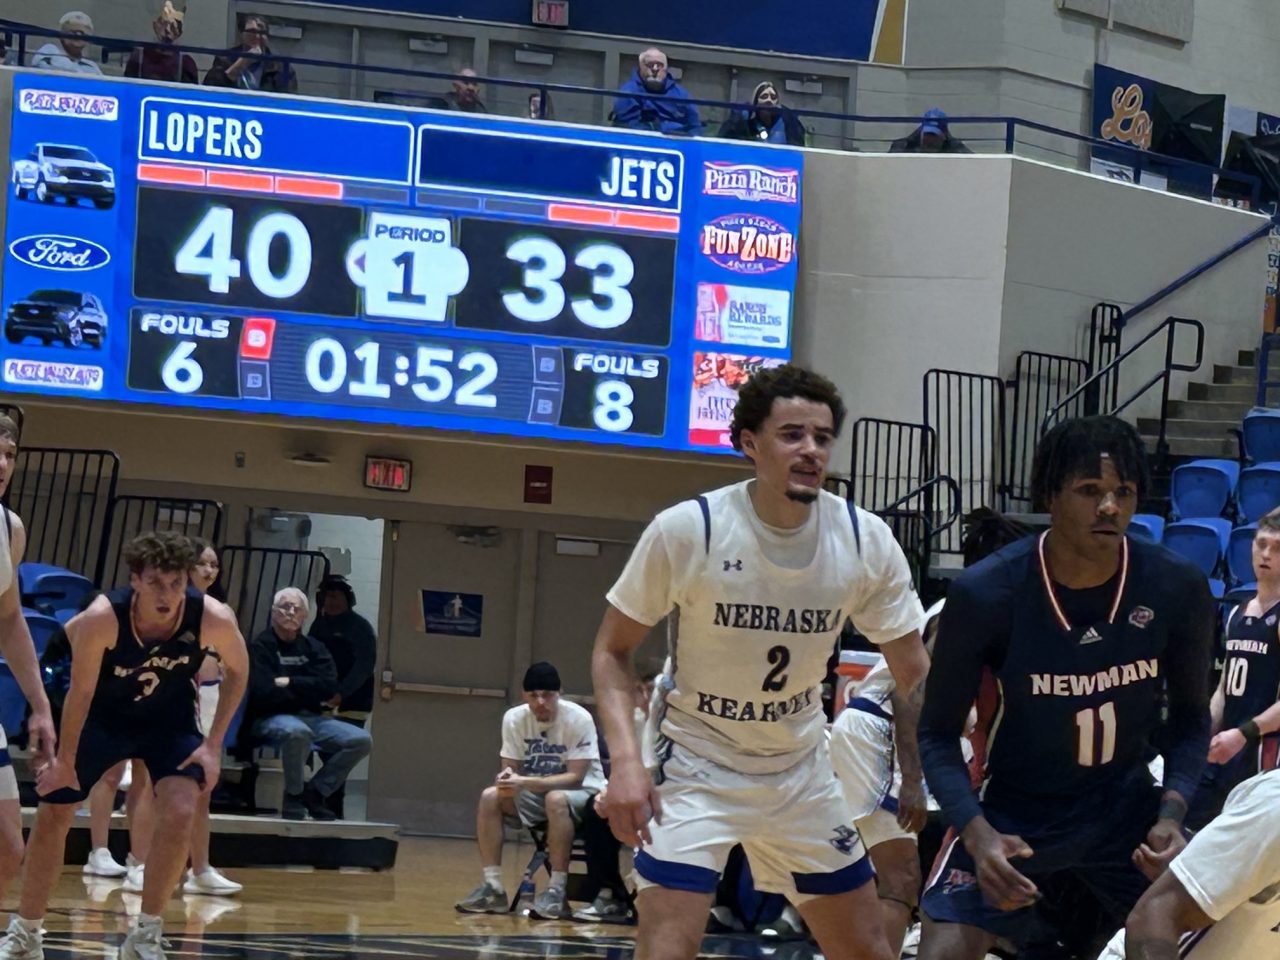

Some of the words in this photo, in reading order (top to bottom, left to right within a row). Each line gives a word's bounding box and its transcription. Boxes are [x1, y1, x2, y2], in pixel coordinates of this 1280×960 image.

[148, 110, 264, 160] LOPERS
[601, 156, 674, 202] JETS
[28, 238, 90, 268] Ford
[174, 206, 312, 299] 40
[375, 223, 446, 243] PERIOD
[386, 251, 427, 306] 1
[502, 236, 634, 330] 33
[140, 313, 230, 339] FOULS
[161, 342, 204, 394] 6
[305, 337, 498, 409] 01:52
[574, 352, 660, 379] FOULS
[592, 381, 635, 432] 8
[761, 644, 791, 692] 2
[1029, 658, 1158, 696] NEWMAN
[1226, 657, 1249, 697] 10
[1076, 701, 1117, 767] 11
